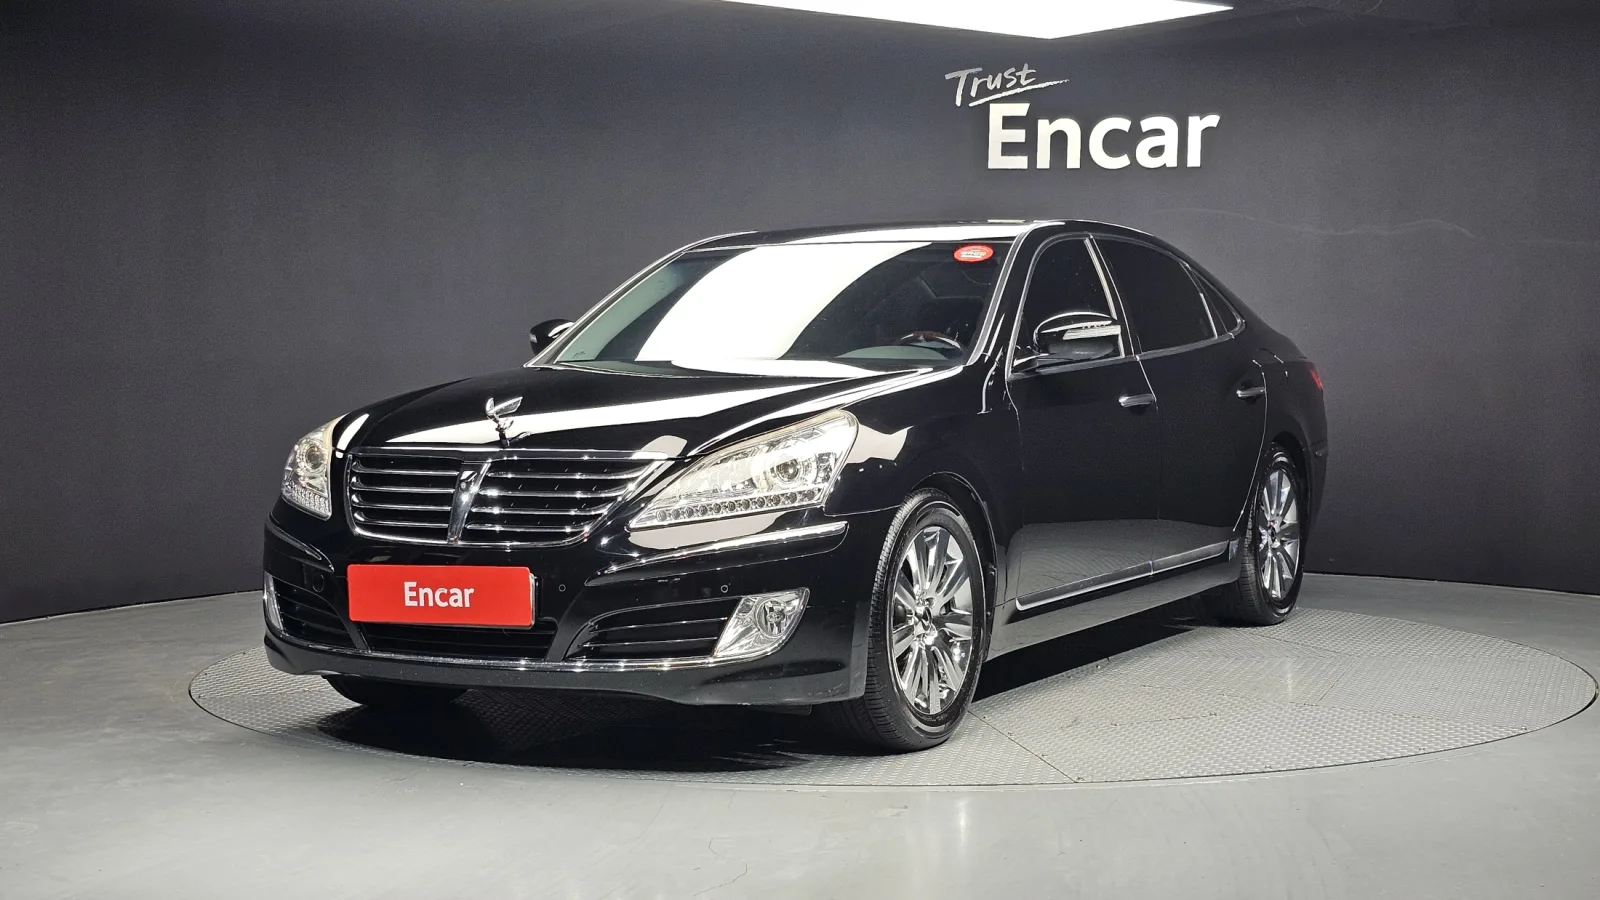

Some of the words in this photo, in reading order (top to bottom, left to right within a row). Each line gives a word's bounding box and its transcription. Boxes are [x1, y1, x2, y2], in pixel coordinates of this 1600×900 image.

[945, 63, 1036, 106] Trust
[988, 102, 1221, 169] Encar
[404, 581, 475, 608] Encar
